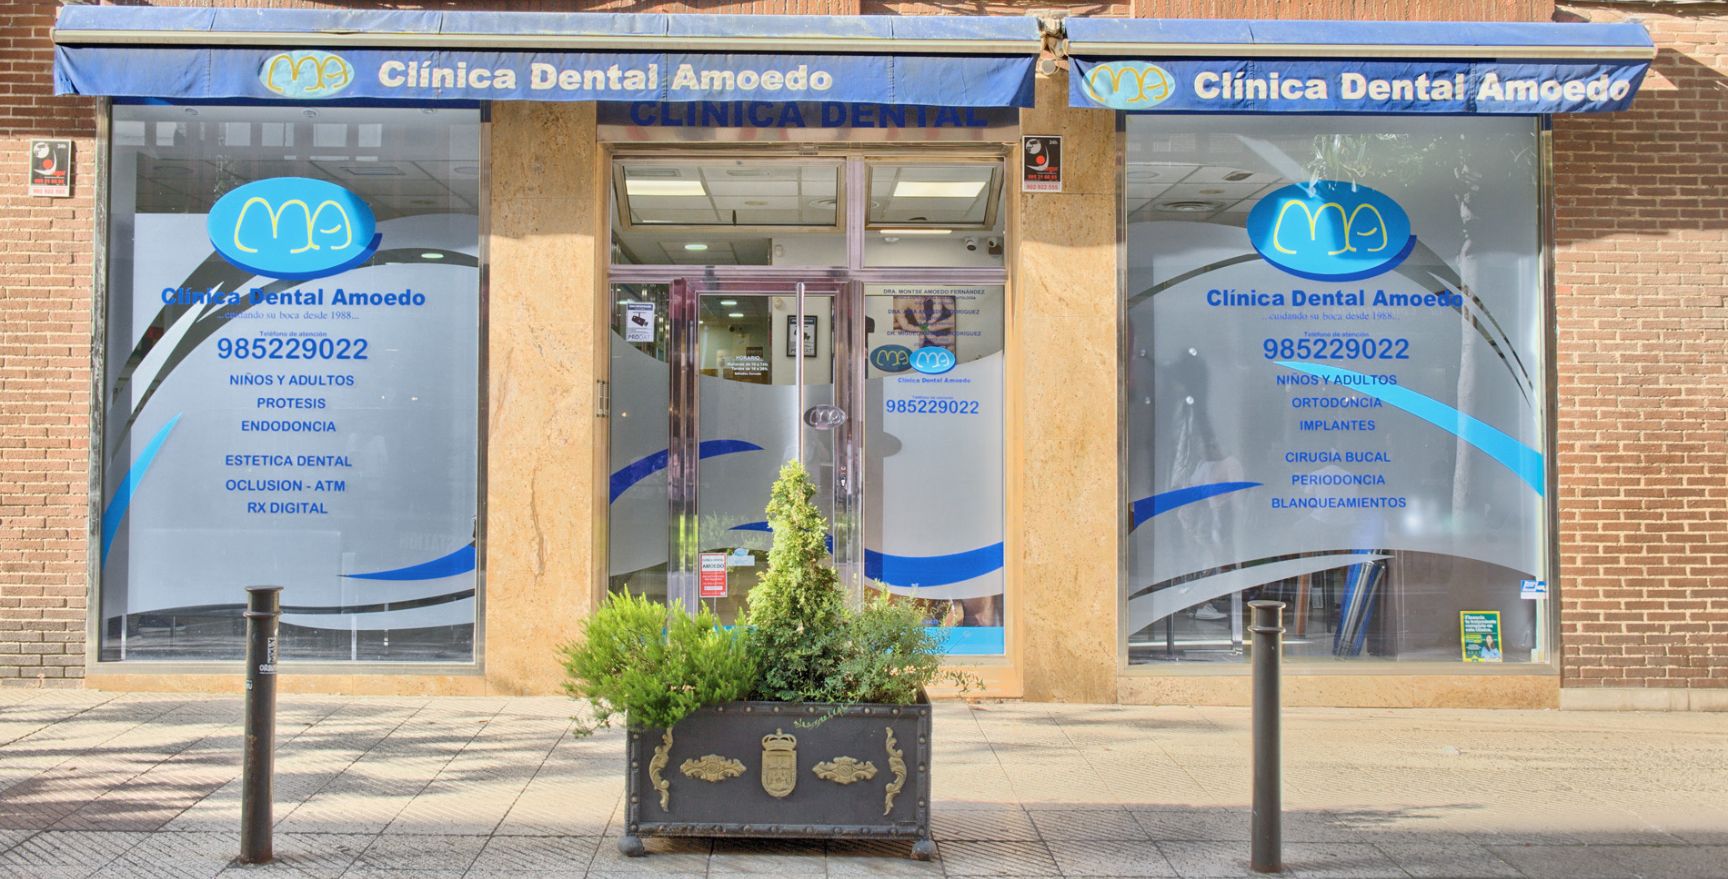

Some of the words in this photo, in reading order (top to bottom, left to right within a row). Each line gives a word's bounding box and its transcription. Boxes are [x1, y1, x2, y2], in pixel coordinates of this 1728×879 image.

[378, 60, 516, 89] Clínica
[531, 63, 658, 90] Dental
[671, 64, 832, 90] Amoedo
[1194, 72, 1328, 100] Clínica
[1341, 72, 1465, 100] Dental
[1477, 72, 1629, 101] Amoedo
[821, 102, 988, 128] DENTAL
[161, 288, 241, 306] Clínica
[250, 288, 324, 306] Dental
[332, 289, 426, 306] Amoedo
[1206, 290, 1284, 306] Clínica
[1292, 290, 1364, 306] Dental
[1373, 290, 1463, 307] Amoedo
[280, 311, 300, 320] boca
[304, 311, 328, 320] desde
[1322, 312, 1342, 320] boca
[1346, 312, 1369, 320] desde
[217, 338, 368, 360] 985229022
[1263, 338, 1410, 360] 985229022
[230, 372, 273, 386] NIÑOS
[277, 375, 285, 385] Y
[288, 375, 354, 386] ADULTOS
[1276, 372, 1318, 385] NIÑOS
[1321, 375, 1330, 384] Y
[1334, 375, 1398, 384] ADULTOS
[257, 398, 326, 408] PROTESIS
[886, 400, 980, 414] 985229022
[1292, 398, 1382, 408] ORTODONCIA
[241, 420, 336, 432] ENDODONCIA
[1300, 420, 1375, 430] IMPLANTES
[225, 455, 293, 466] ESTETICA
[297, 456, 352, 467] DENTAL
[1286, 452, 1342, 462] CIRUGIA
[1346, 452, 1391, 462] BUCAL
[1292, 474, 1386, 485] PERIODONCIA
[226, 480, 302, 491] OCLUSION
[314, 480, 346, 492] ATM
[248, 502, 266, 513] RX
[270, 502, 328, 514] DIGITAL
[1272, 498, 1406, 508] BLANQUEAMIENTOS
